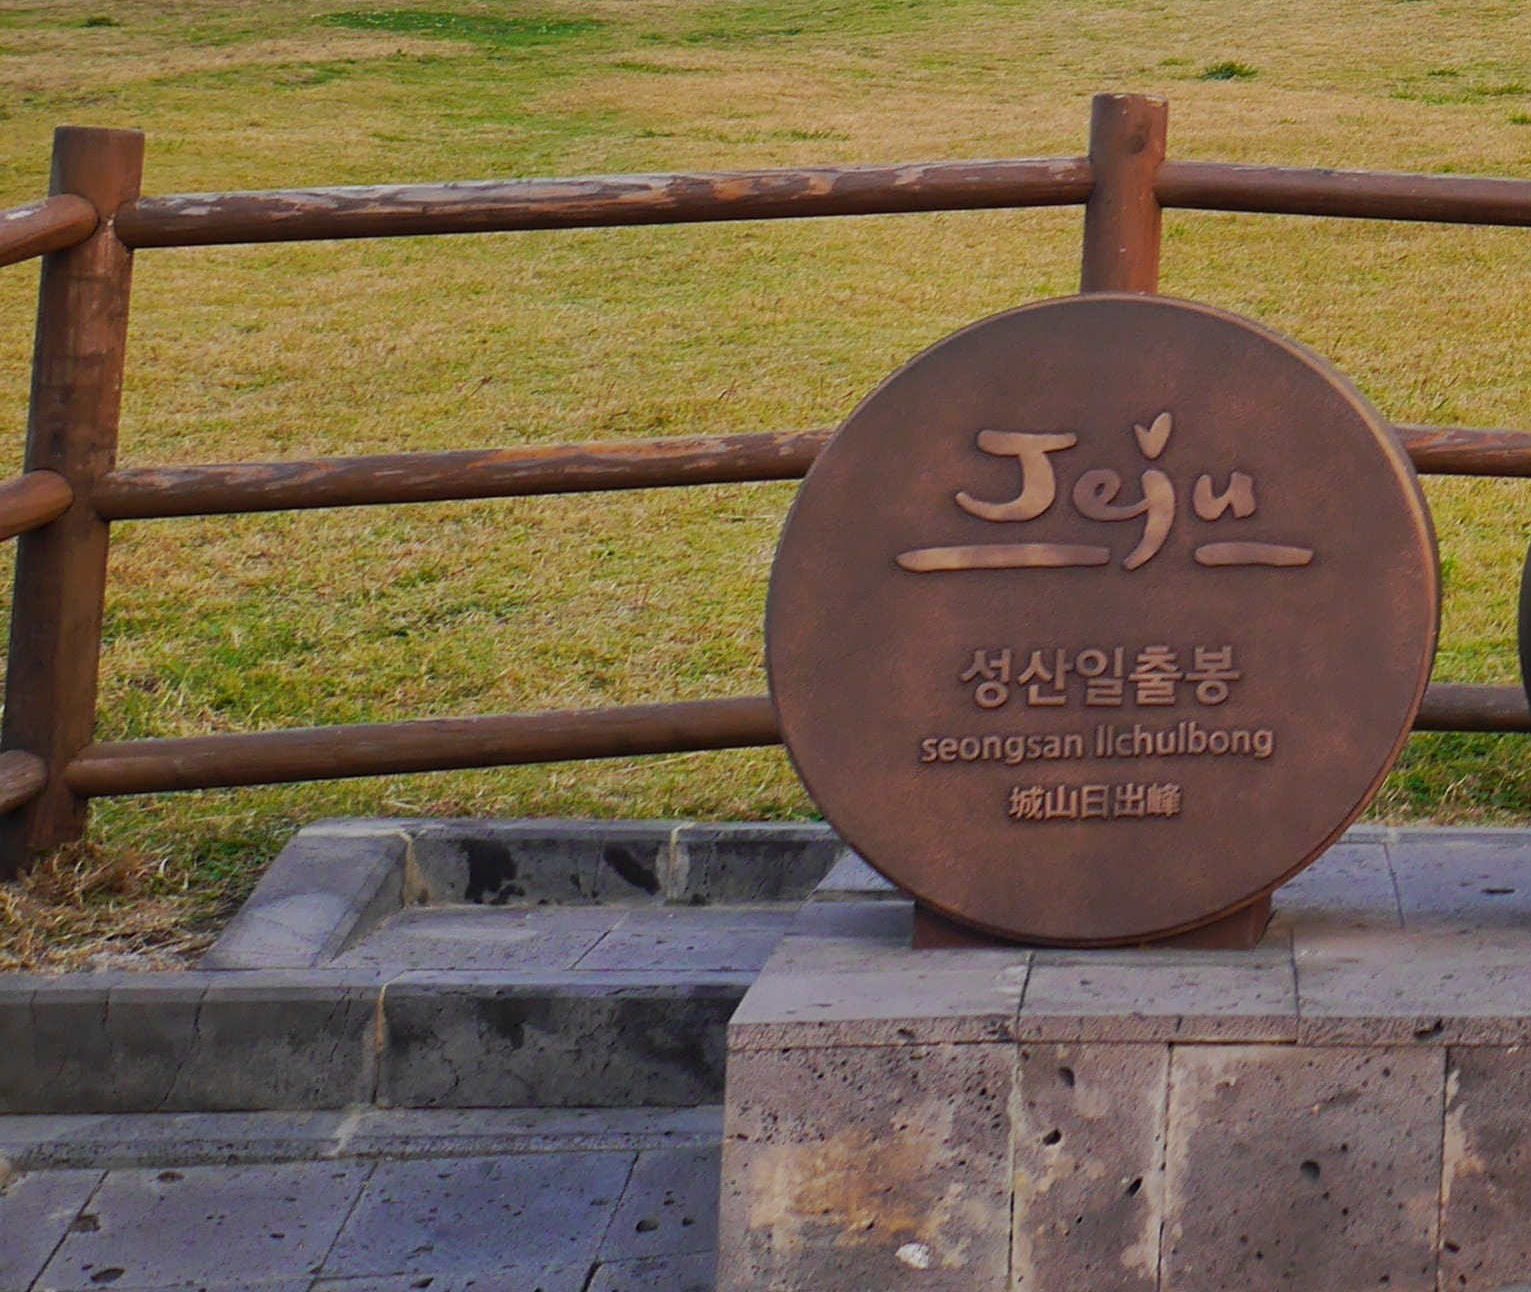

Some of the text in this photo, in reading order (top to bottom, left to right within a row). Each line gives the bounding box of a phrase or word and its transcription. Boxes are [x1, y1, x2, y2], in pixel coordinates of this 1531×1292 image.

[955, 411, 1257, 571] Jeju
[959, 644, 1242, 708] 성산일출봉
[920, 731, 1083, 765] seongsan
[1009, 782, 1181, 821] 城山日出峰
